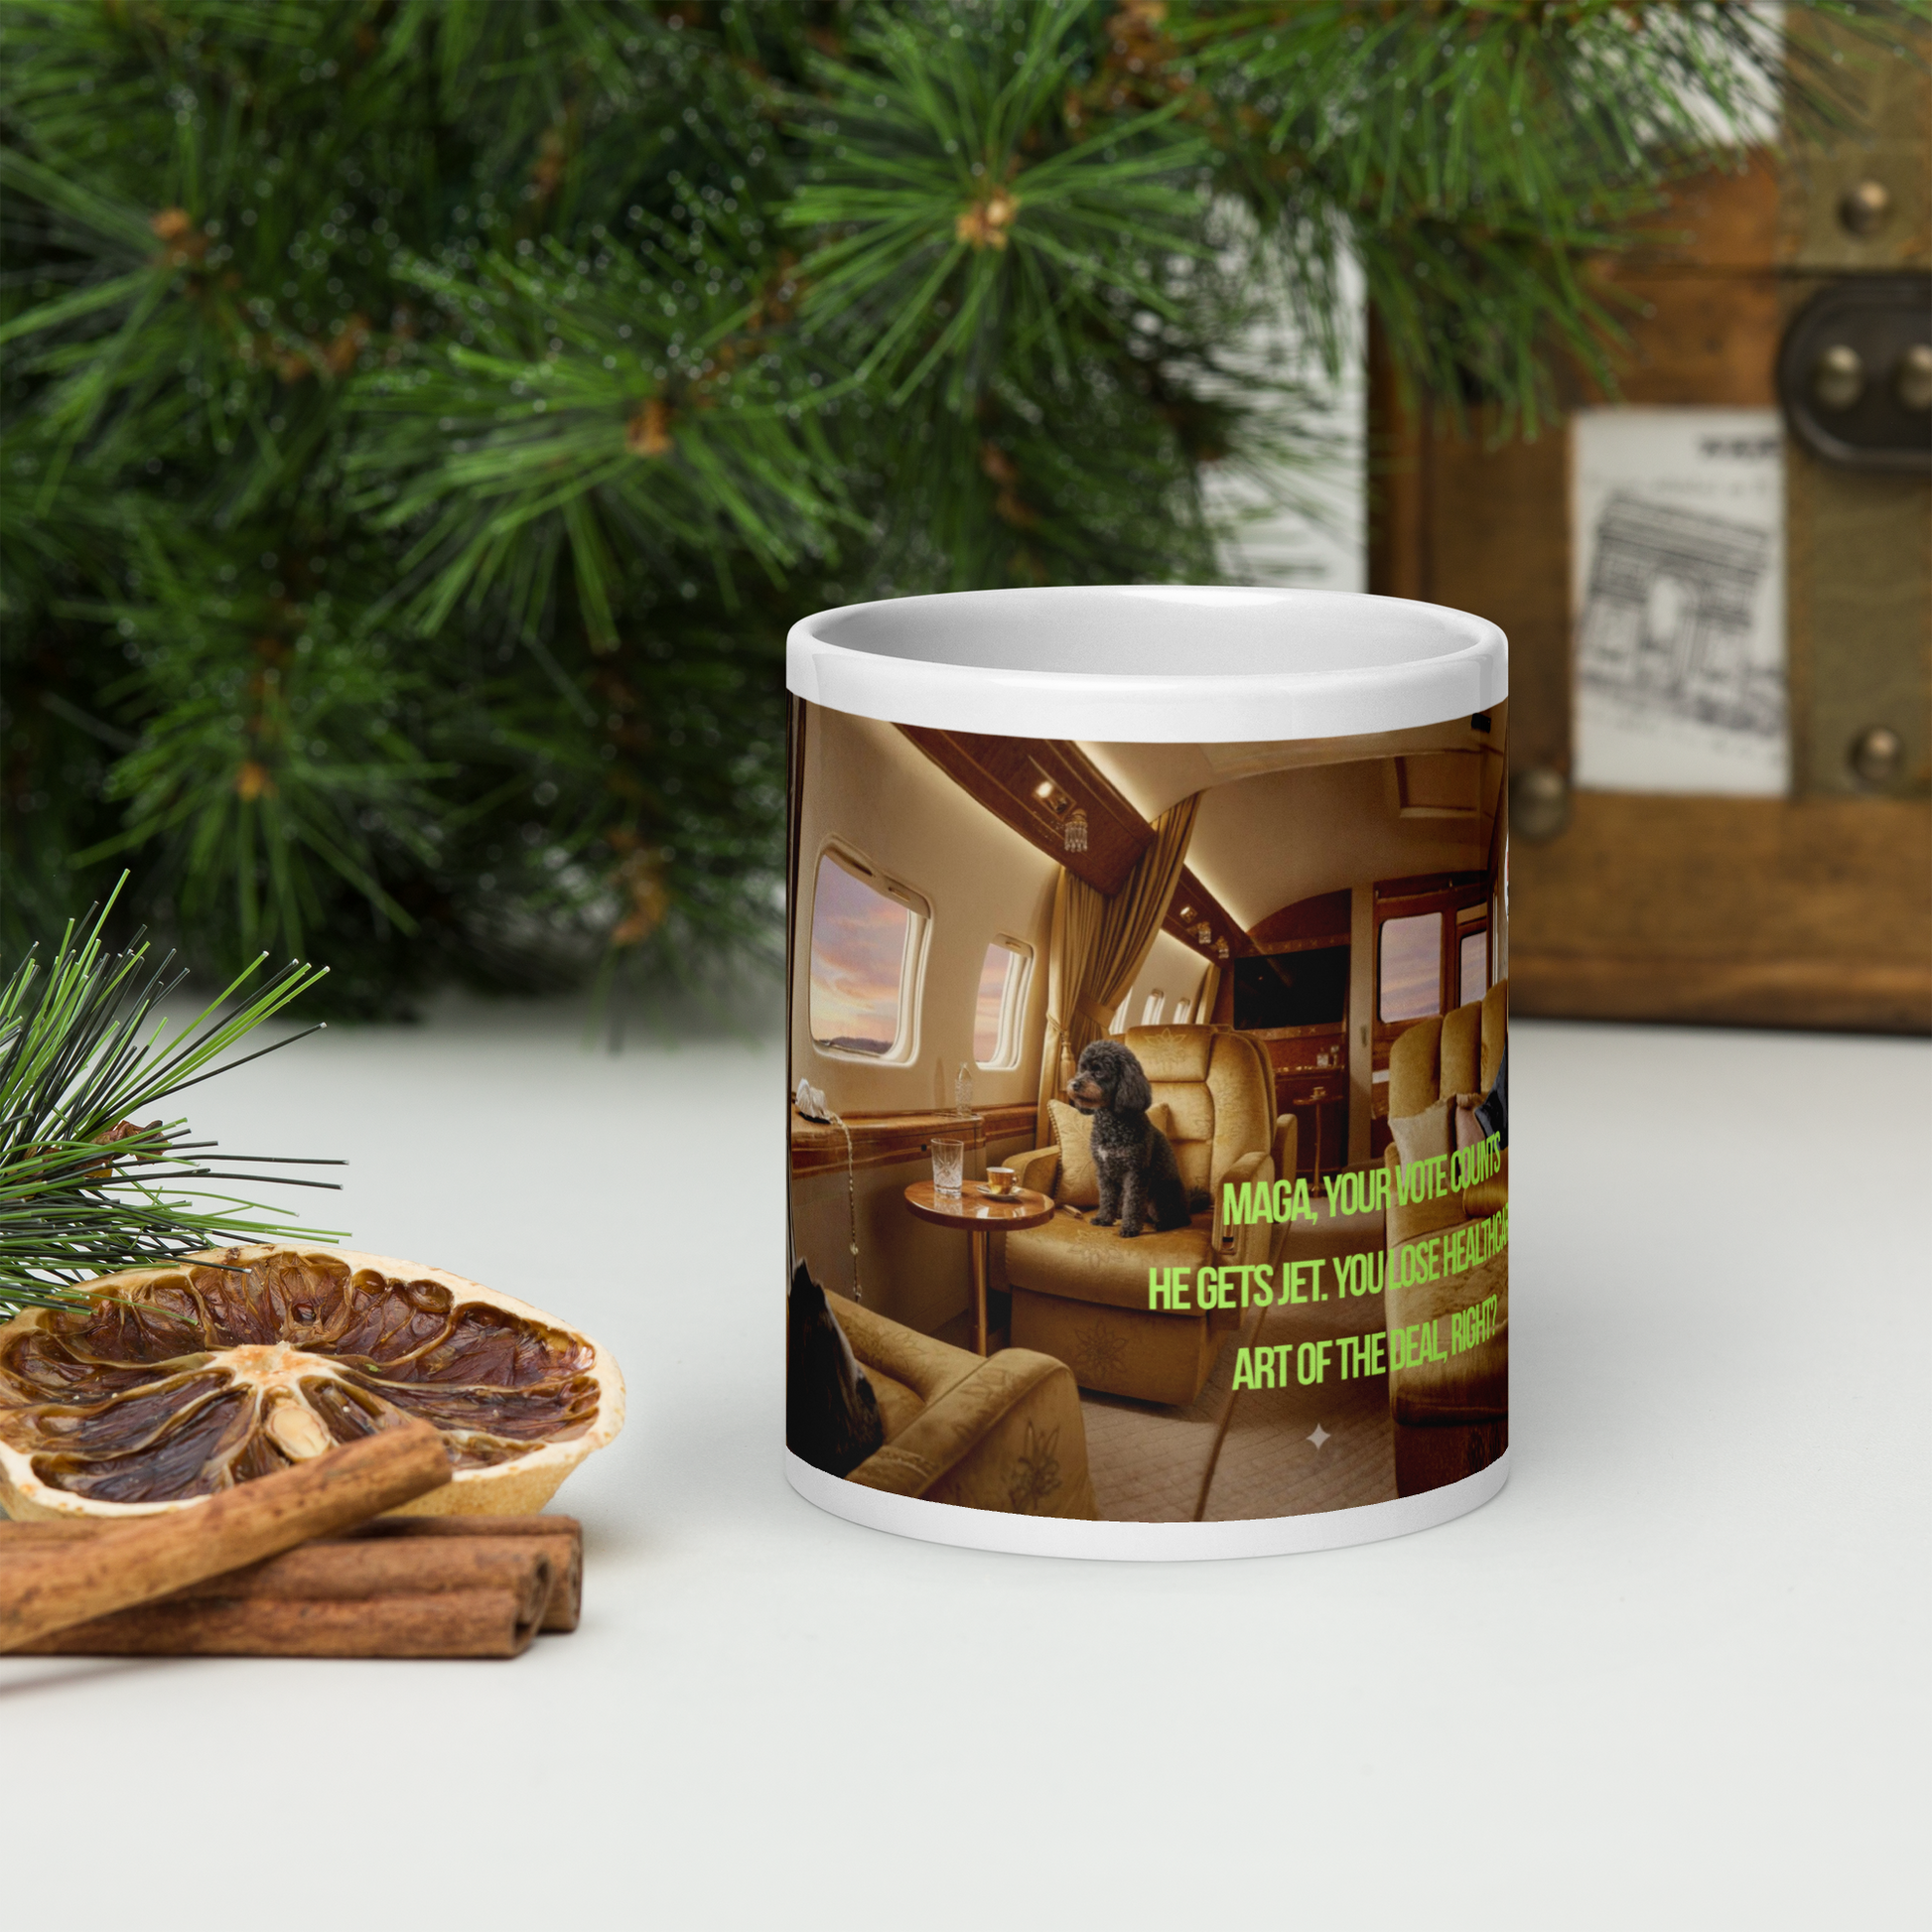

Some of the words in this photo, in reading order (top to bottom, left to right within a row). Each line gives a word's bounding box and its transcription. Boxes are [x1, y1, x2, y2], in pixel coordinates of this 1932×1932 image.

[1223, 1178, 1318, 1225] MAGA,
[1323, 1168, 1391, 1217] YOUR
[1396, 1154, 1448, 1206] VOTE
[1450, 1131, 1501, 1192] COUNTS
[1149, 1267, 1190, 1310] HE
[1196, 1264, 1274, 1310] GETS
[1278, 1259, 1328, 1306] JET.
[1333, 1250, 1384, 1299] YOU
[1389, 1240, 1440, 1290] LOSE
[1232, 1344, 1293, 1390] ART
[1297, 1340, 1332, 1385] OF
[1336, 1331, 1386, 1380] THE
[1390, 1318, 1448, 1371] DEAL,
[1451, 1295, 1497, 1356] RIGHT?
